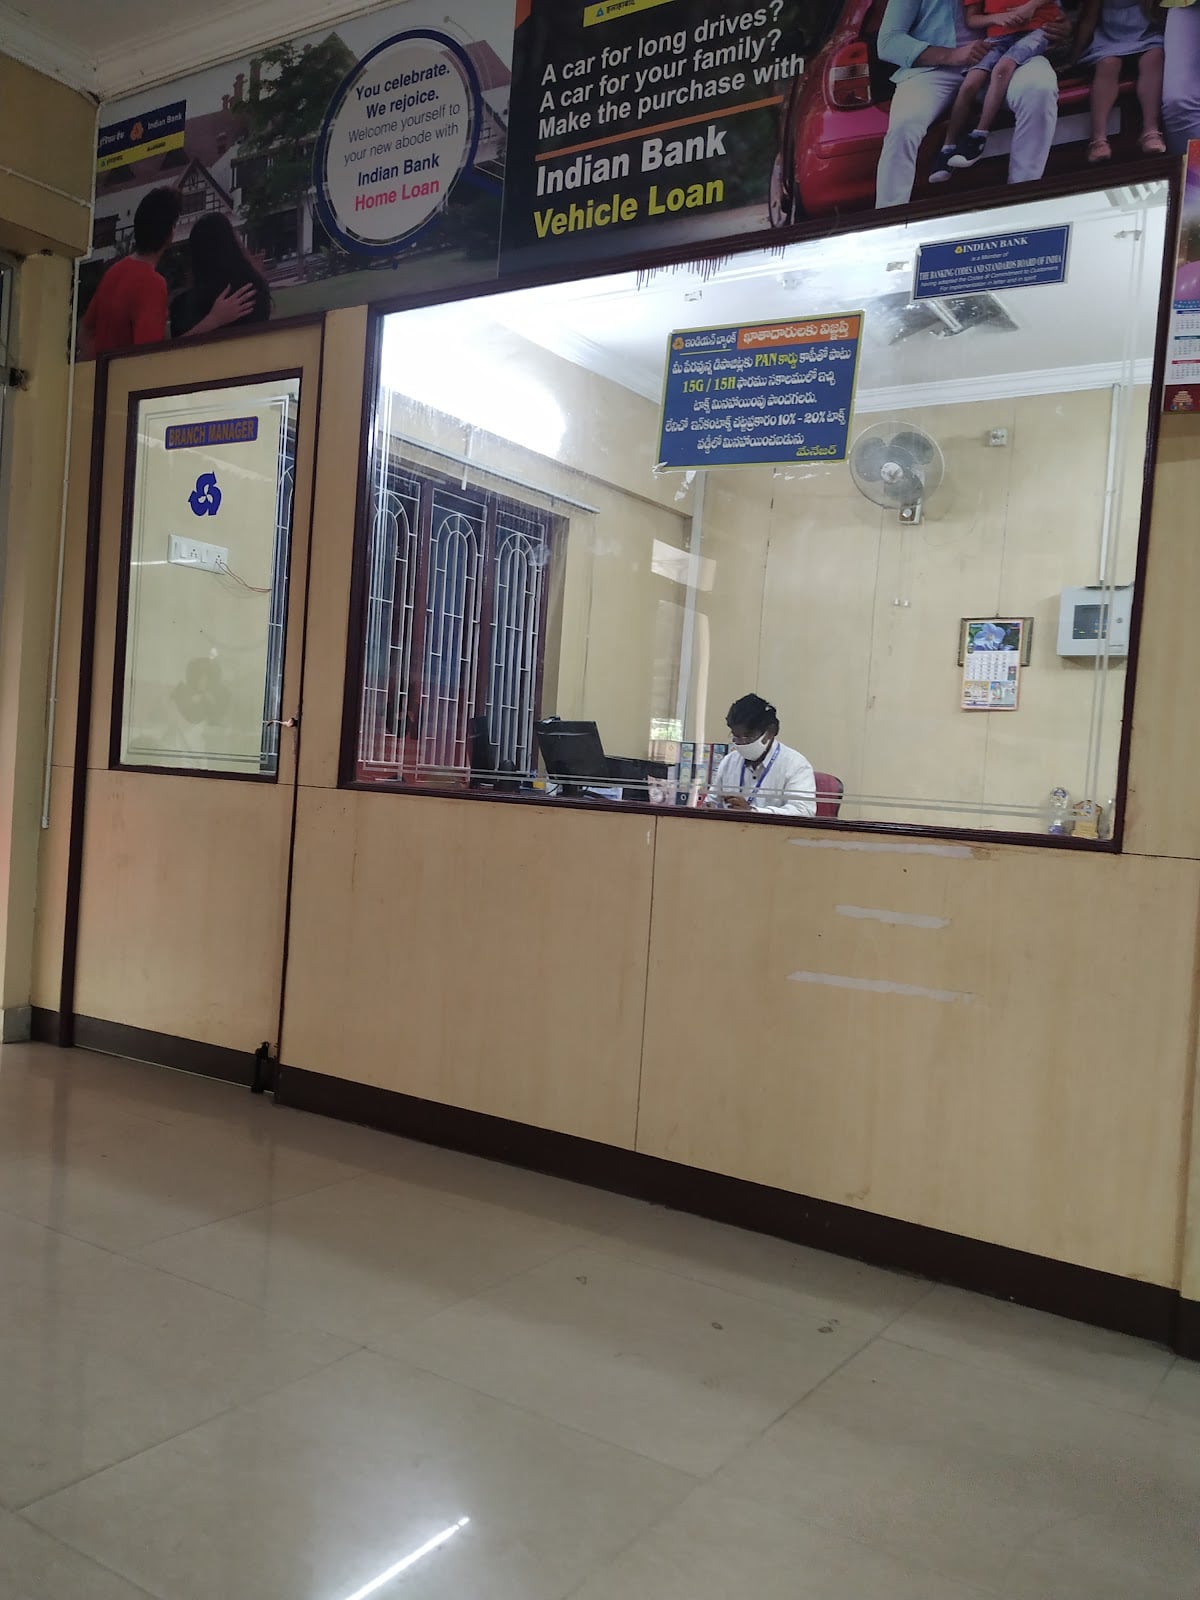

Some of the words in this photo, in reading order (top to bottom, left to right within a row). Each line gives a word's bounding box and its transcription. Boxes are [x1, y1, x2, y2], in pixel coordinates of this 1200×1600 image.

[541, 63, 557, 86] A
[562, 54, 595, 80] car
[601, 44, 632, 69] for
[638, 30, 687, 59] long
[694, 0, 784, 43] drives?
[356, 83, 380, 100] You
[385, 64, 450, 92] celebrate.
[539, 91, 555, 113] A
[560, 82, 594, 107] car
[599, 72, 630, 97] for
[635, 57, 687, 93] your
[693, 28, 782, 73] family?
[366, 104, 386, 119] We
[390, 89, 439, 112] rejoice.
[538, 110, 591, 140] Make
[598, 101, 631, 125] the
[637, 71, 745, 119] purchase
[753, 53, 805, 85] with
[147, 119, 165, 131] Indian
[166, 112, 182, 124] Bank
[348, 120, 397, 143] Welcome
[401, 104, 445, 130] yourself
[449, 104, 460, 116] to
[344, 149, 367, 167] your
[370, 142, 393, 155] new
[396, 130, 432, 150] abode
[436, 123, 459, 140] with
[358, 165, 398, 187] Indian
[404, 153, 440, 175] Bank
[536, 151, 630, 197] Indian
[640, 125, 728, 173] Bank
[355, 190, 397, 212] Home
[402, 180, 440, 200] Loan
[534, 193, 638, 239] Vehicle
[648, 179, 724, 216] Loan
[963, 241, 999, 253] INDIAN
[1000, 236, 1028, 248] BANK
[920, 271, 929, 281] THE
[930, 268, 954, 279] BANKING
[955, 265, 973, 276] CODES
[974, 264, 985, 274] AND
[985, 260, 1017, 272] STANDARDS
[1016, 257, 1037, 268] BOARD
[1037, 256, 1045, 266] OF
[1045, 254, 1062, 265] INDIA
[685, 333, 716, 348] ఇండియన్
[716, 331, 737, 349] బ్యాంక్
[743, 324, 818, 345] ఖాతాదారులకు
[672, 361, 683, 374] మీ
[754, 353, 777, 367] PAN
[778, 352, 798, 369] కార్డు
[829, 347, 852, 361] పాటు
[683, 379, 704, 393] 15G
[706, 378, 712, 393] /
[714, 376, 736, 391] 15H
[768, 368, 817, 386] సకాలములో
[711, 394, 766, 410] మినహాయింపు
[169, 425, 205, 447] BRANCH
[208, 420, 254, 441] MANAGER
[665, 417, 689, 432] లేనిచో
[777, 412, 796, 426] 10%
[803, 410, 826, 424] 20%
[796, 444, 837, 456] మేనేజర్
